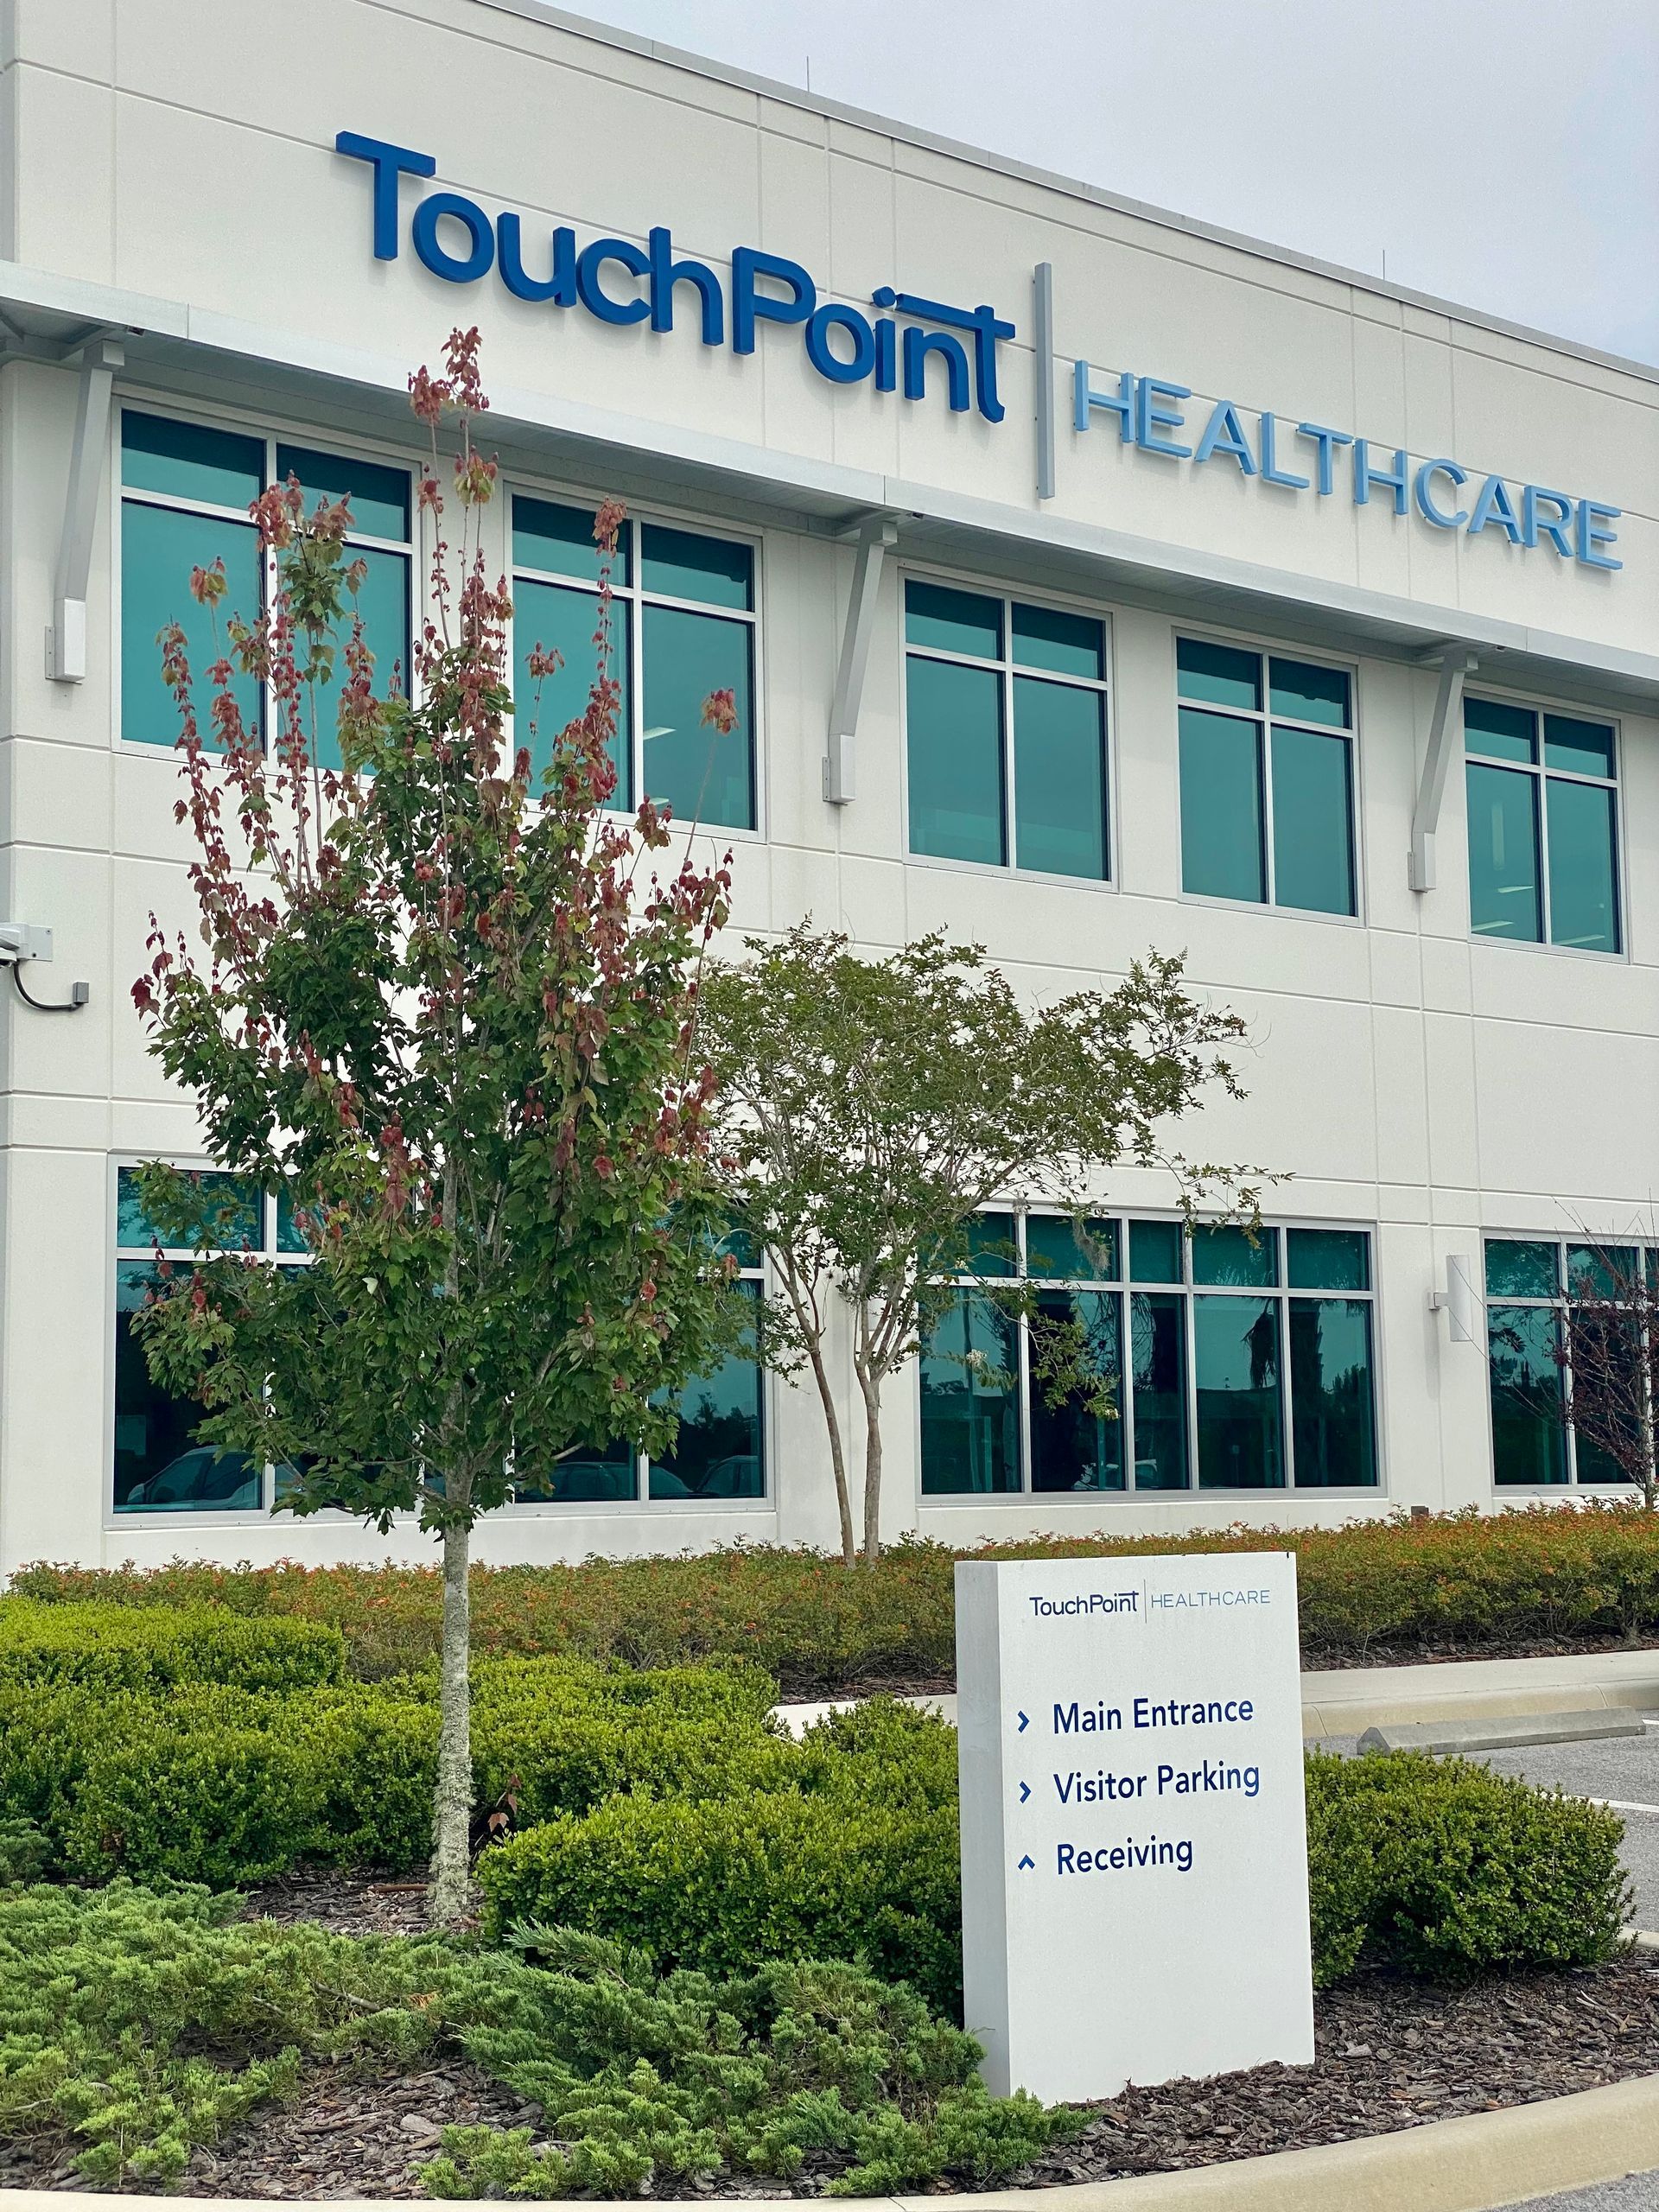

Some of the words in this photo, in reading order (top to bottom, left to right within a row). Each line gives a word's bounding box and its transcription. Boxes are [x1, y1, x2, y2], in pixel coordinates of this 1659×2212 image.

[335, 130, 1016, 423] TouchPoint
[1074, 359, 1624, 570] HEALTHCARE
[1029, 1590, 1140, 1617] TouchPoint
[1151, 1590, 1270, 1608] HEALTHCARE
[1053, 1700, 1122, 1733] Main
[1133, 1698, 1254, 1728] Entrance
[1053, 1771, 1147, 1803] Visitor
[1158, 1760, 1260, 1796] Parking
[1057, 1835, 1193, 1874] Receiving
